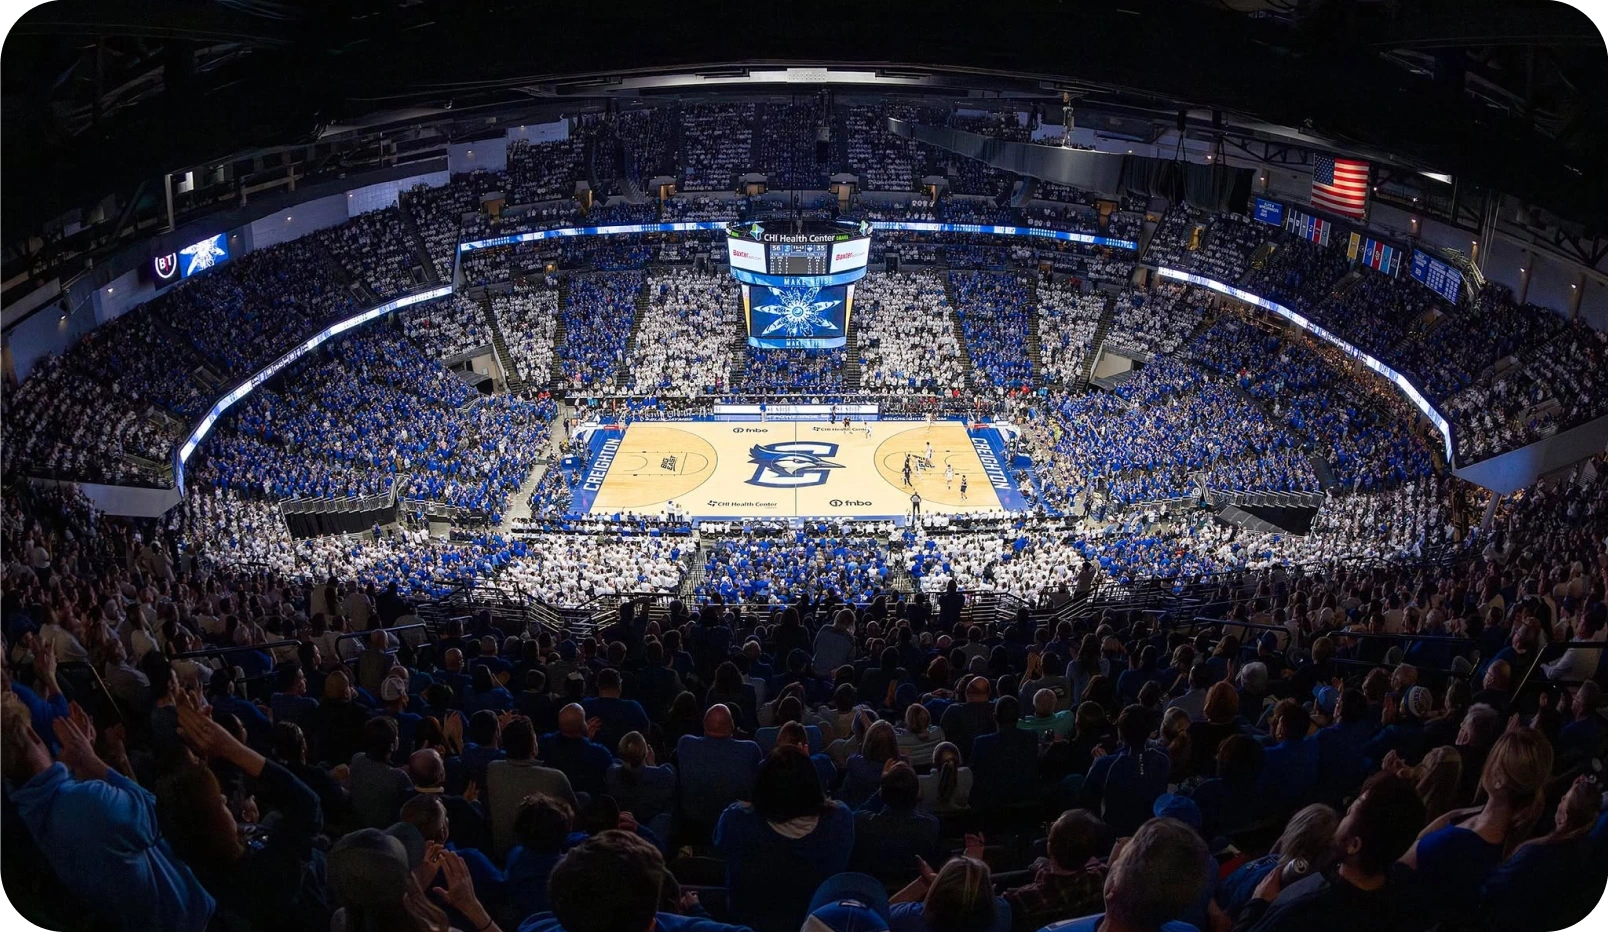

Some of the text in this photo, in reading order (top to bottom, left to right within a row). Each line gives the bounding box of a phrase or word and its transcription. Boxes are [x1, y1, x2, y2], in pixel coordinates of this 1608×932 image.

[764, 234, 778, 242] CHI
[780, 234, 807, 243] Health
[809, 234, 835, 242] Center
[733, 249, 749, 258] Baxter
[836, 252, 852, 261] Baxter
[784, 276, 833, 286] MAKE NOISE
[583, 438, 621, 491] CREIGHTON
[660, 457, 669, 469] BIG
[667, 455, 676, 472] EAST
[971, 437, 1012, 490] CREIGHTON
